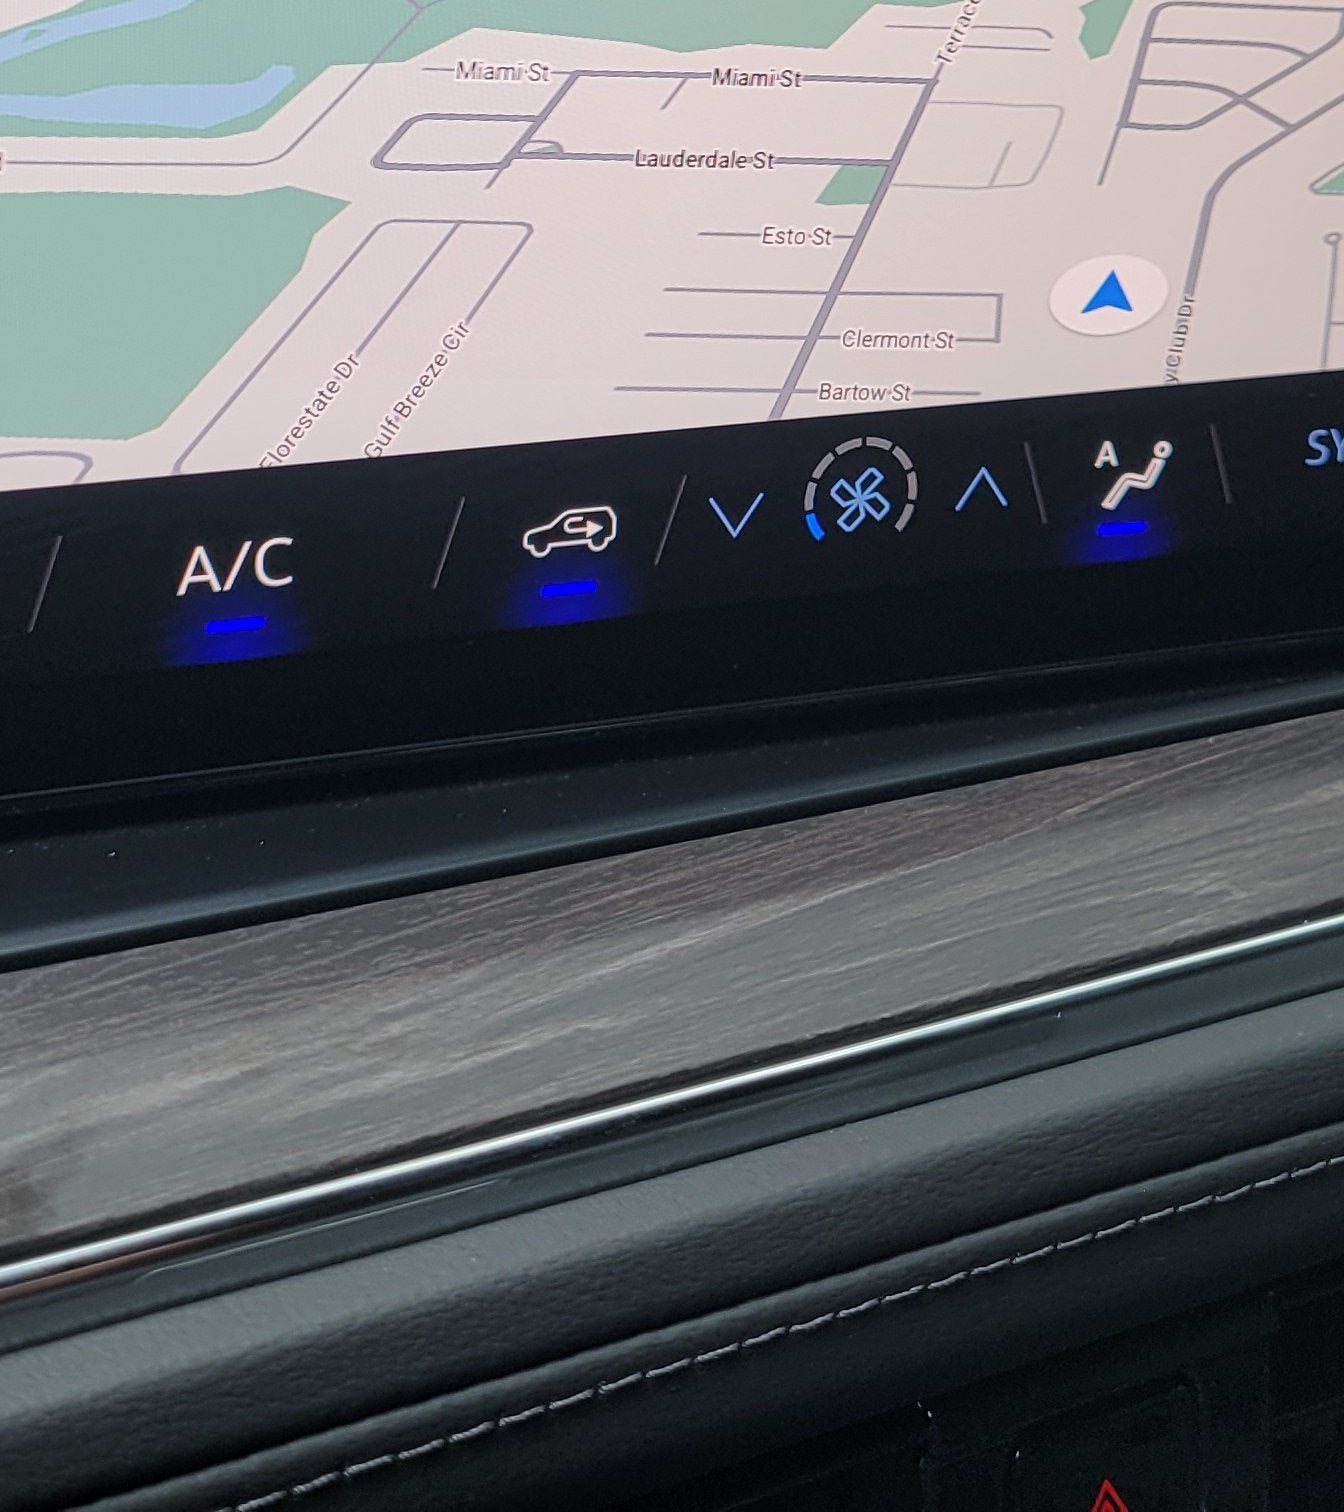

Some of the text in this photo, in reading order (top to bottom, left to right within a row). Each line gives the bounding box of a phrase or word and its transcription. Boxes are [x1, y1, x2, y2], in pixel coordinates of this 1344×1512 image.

[457, 62, 549, 82] Miami St
[711, 69, 802, 87] Miami St
[635, 150, 774, 169] Lauderdale St
[762, 227, 832, 245] Esto St
[842, 331, 954, 349] Clermont St
[1166, 325, 1189, 368] Club
[1178, 296, 1194, 322] Dr
[334, 354, 360, 381] Dr
[364, 322, 470, 458] Gulf Breeze Cir
[819, 384, 911, 402] Bartow St
[1095, 441, 1118, 467] A
[177, 536, 294, 597] A/C
